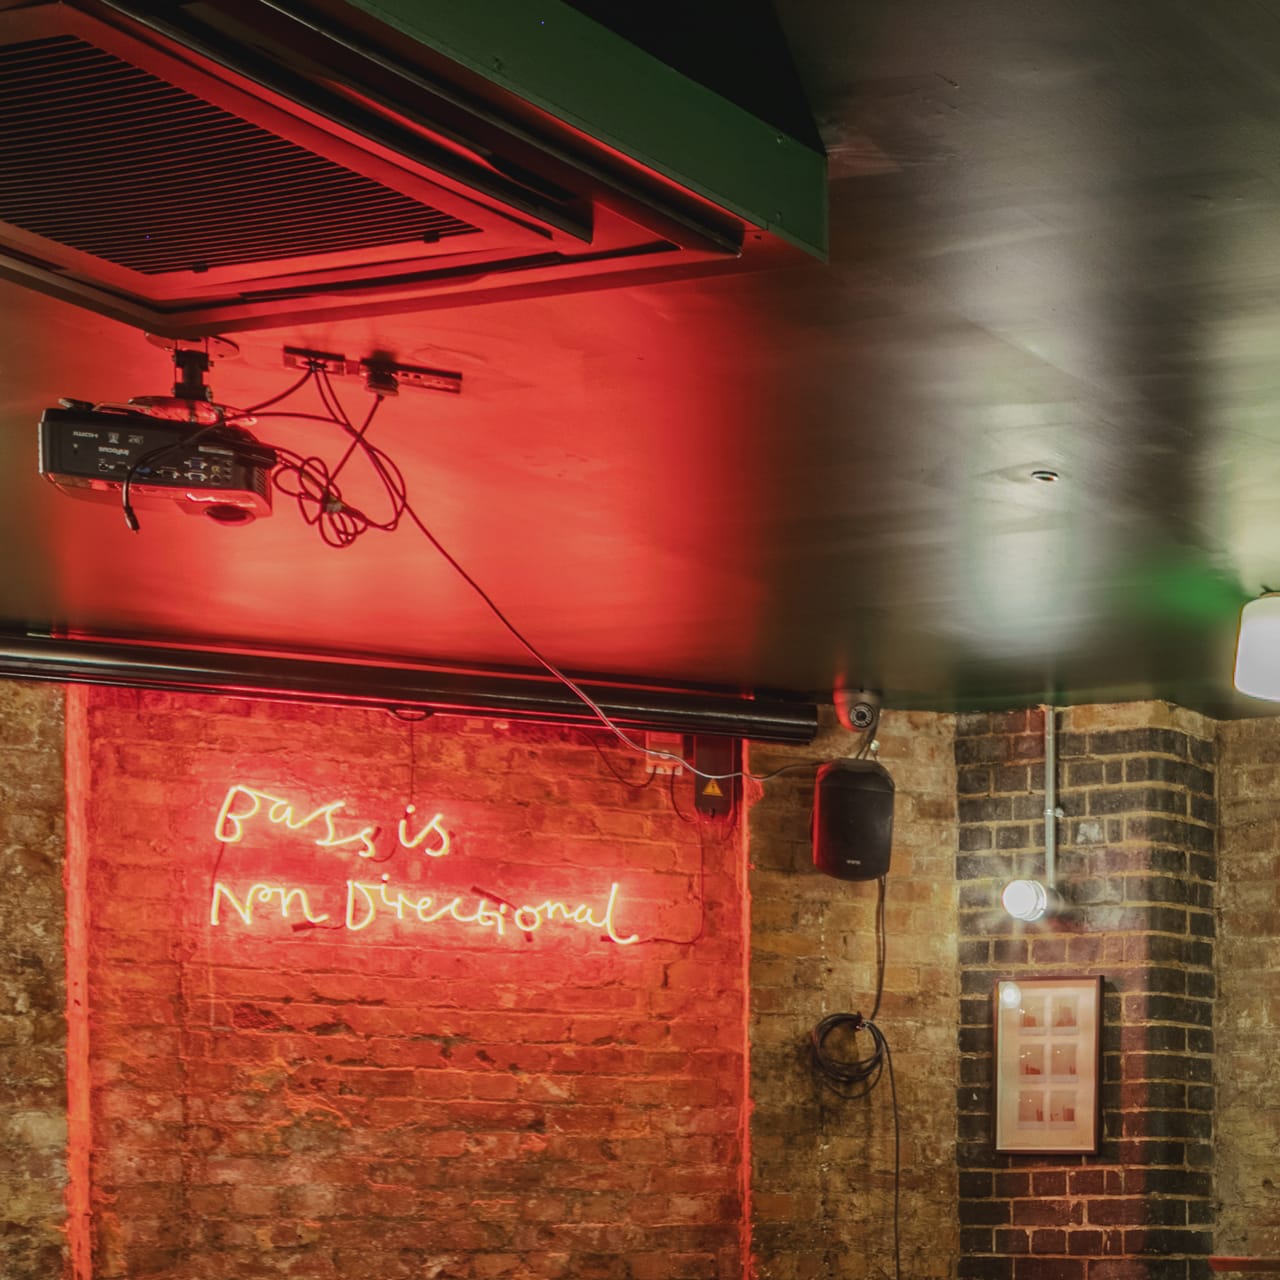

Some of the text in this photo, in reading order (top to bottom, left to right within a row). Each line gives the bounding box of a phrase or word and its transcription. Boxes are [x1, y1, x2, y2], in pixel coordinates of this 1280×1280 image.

[214, 784, 450, 858] Bass is
[210, 873, 640, 945] Non Directional
